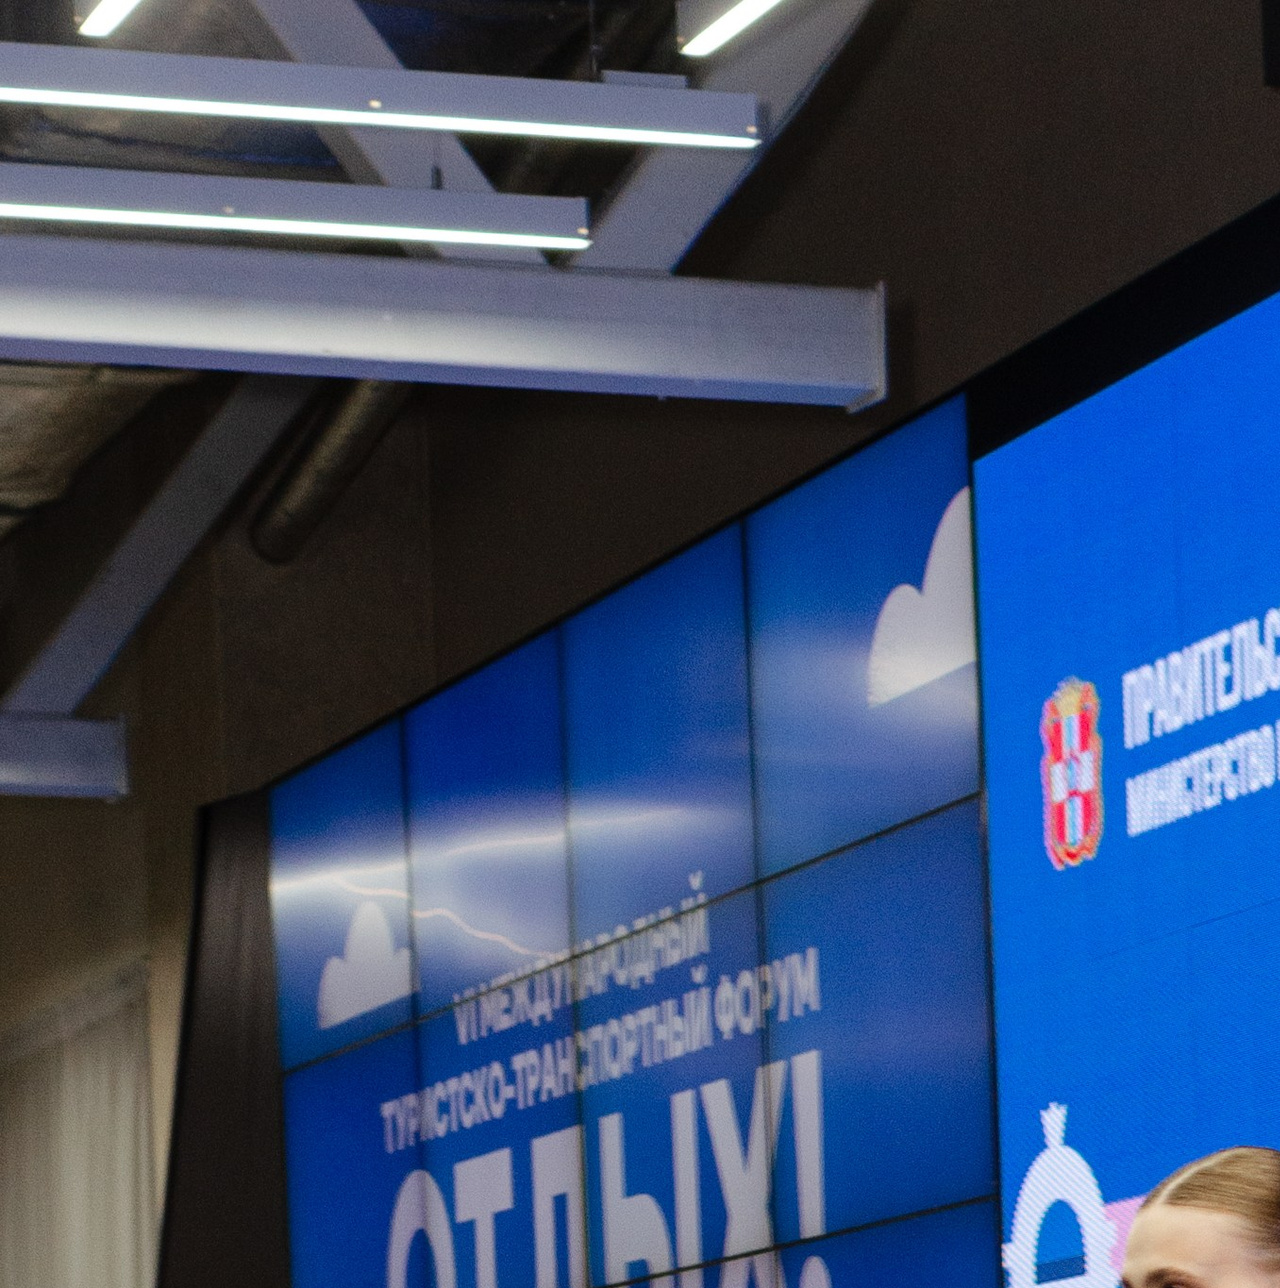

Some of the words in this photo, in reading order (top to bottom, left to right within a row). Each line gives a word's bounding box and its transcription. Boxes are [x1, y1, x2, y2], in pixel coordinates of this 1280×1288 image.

[477, 870, 710, 1039] МЕЖДУНАРОДНЫЙ
[380, 964, 713, 1153] ТУРИСТСКО-ТРАНСПОРТНЫЙ
[715, 947, 821, 1040] ФОРУМ
